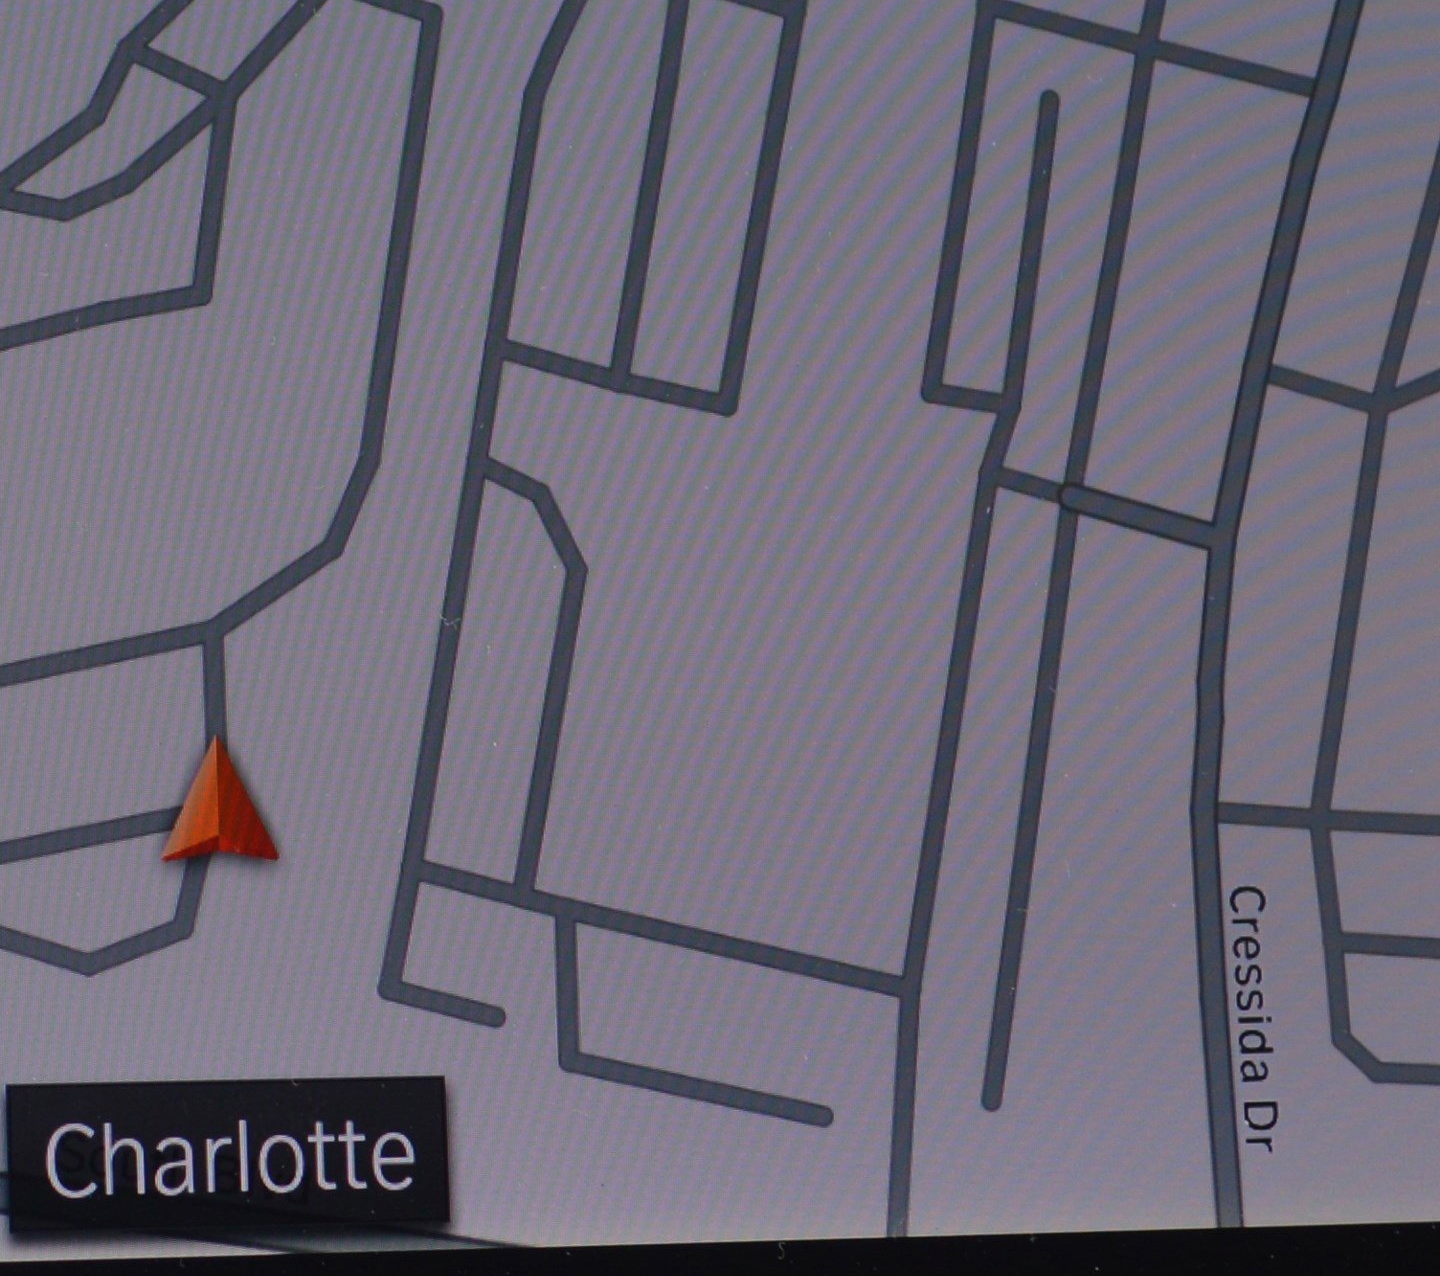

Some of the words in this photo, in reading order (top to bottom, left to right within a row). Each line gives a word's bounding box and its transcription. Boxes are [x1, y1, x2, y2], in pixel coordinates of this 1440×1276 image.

[1227, 883, 1275, 1086] Cressida
[45, 1119, 416, 1199] Charlotte
[1243, 1100, 1279, 1151] Dr
